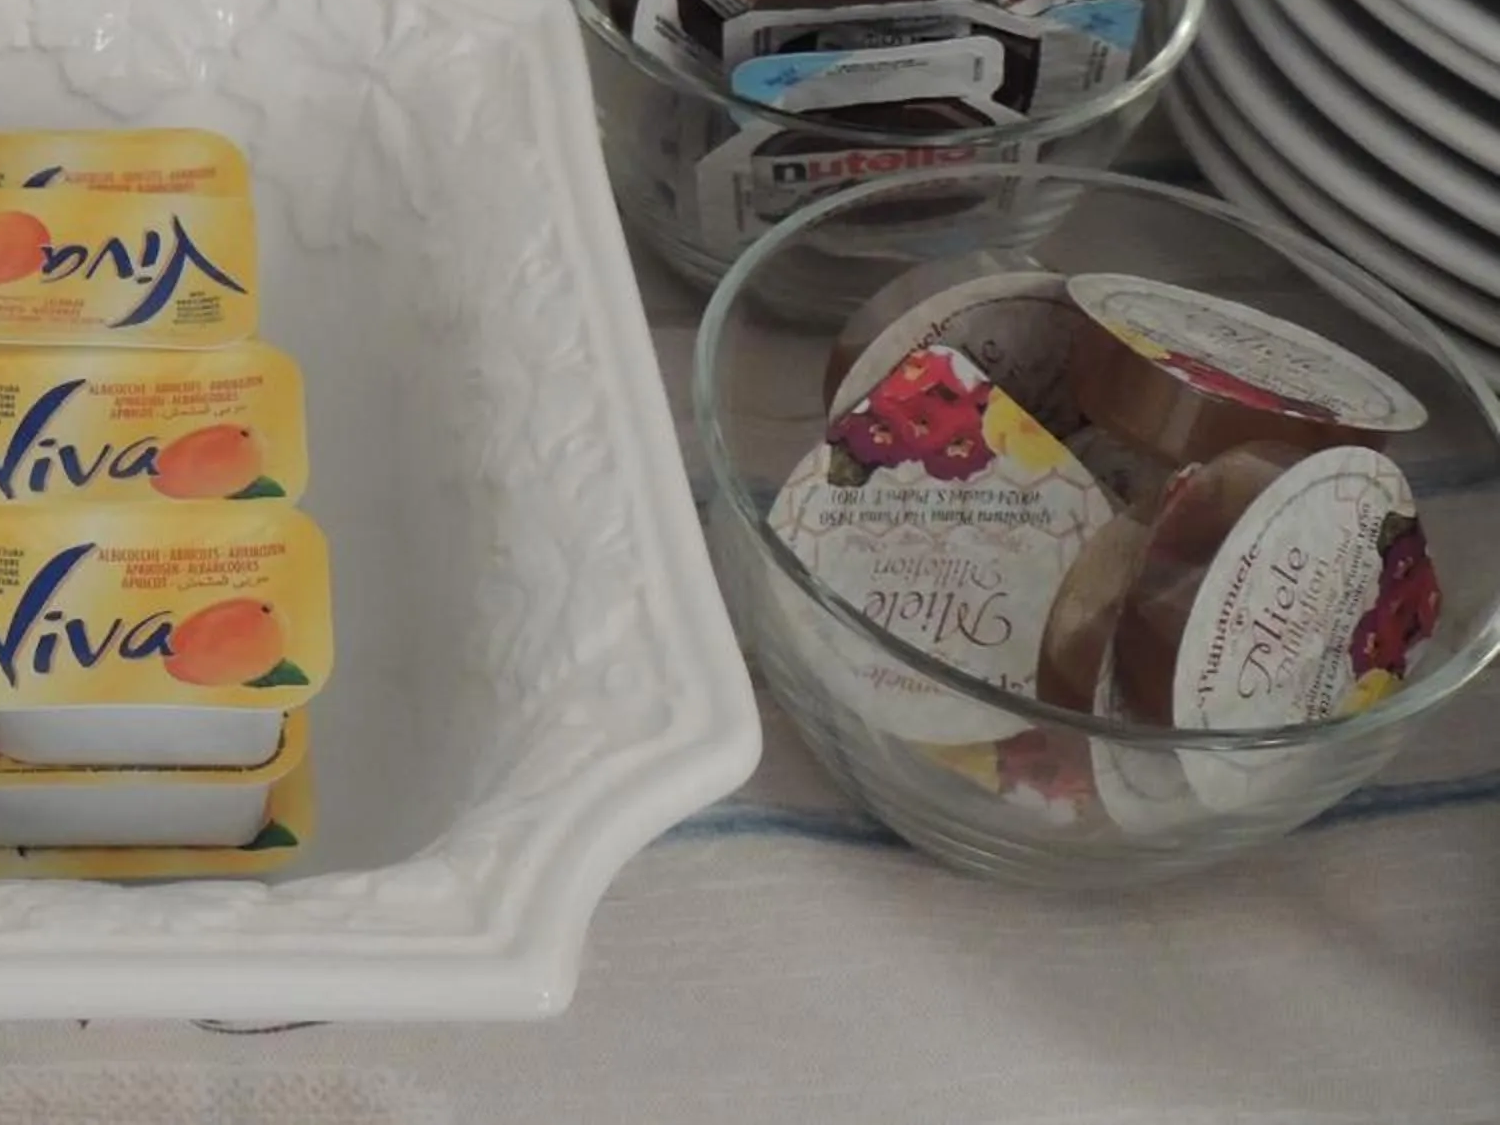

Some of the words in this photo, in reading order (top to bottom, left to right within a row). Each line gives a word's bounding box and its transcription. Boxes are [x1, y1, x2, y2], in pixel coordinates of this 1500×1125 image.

[772, 145, 977, 183] nutella
[39, 213, 248, 328] Viva
[864, 589, 1011, 646] Miele
[1238, 546, 1309, 698] Miele
